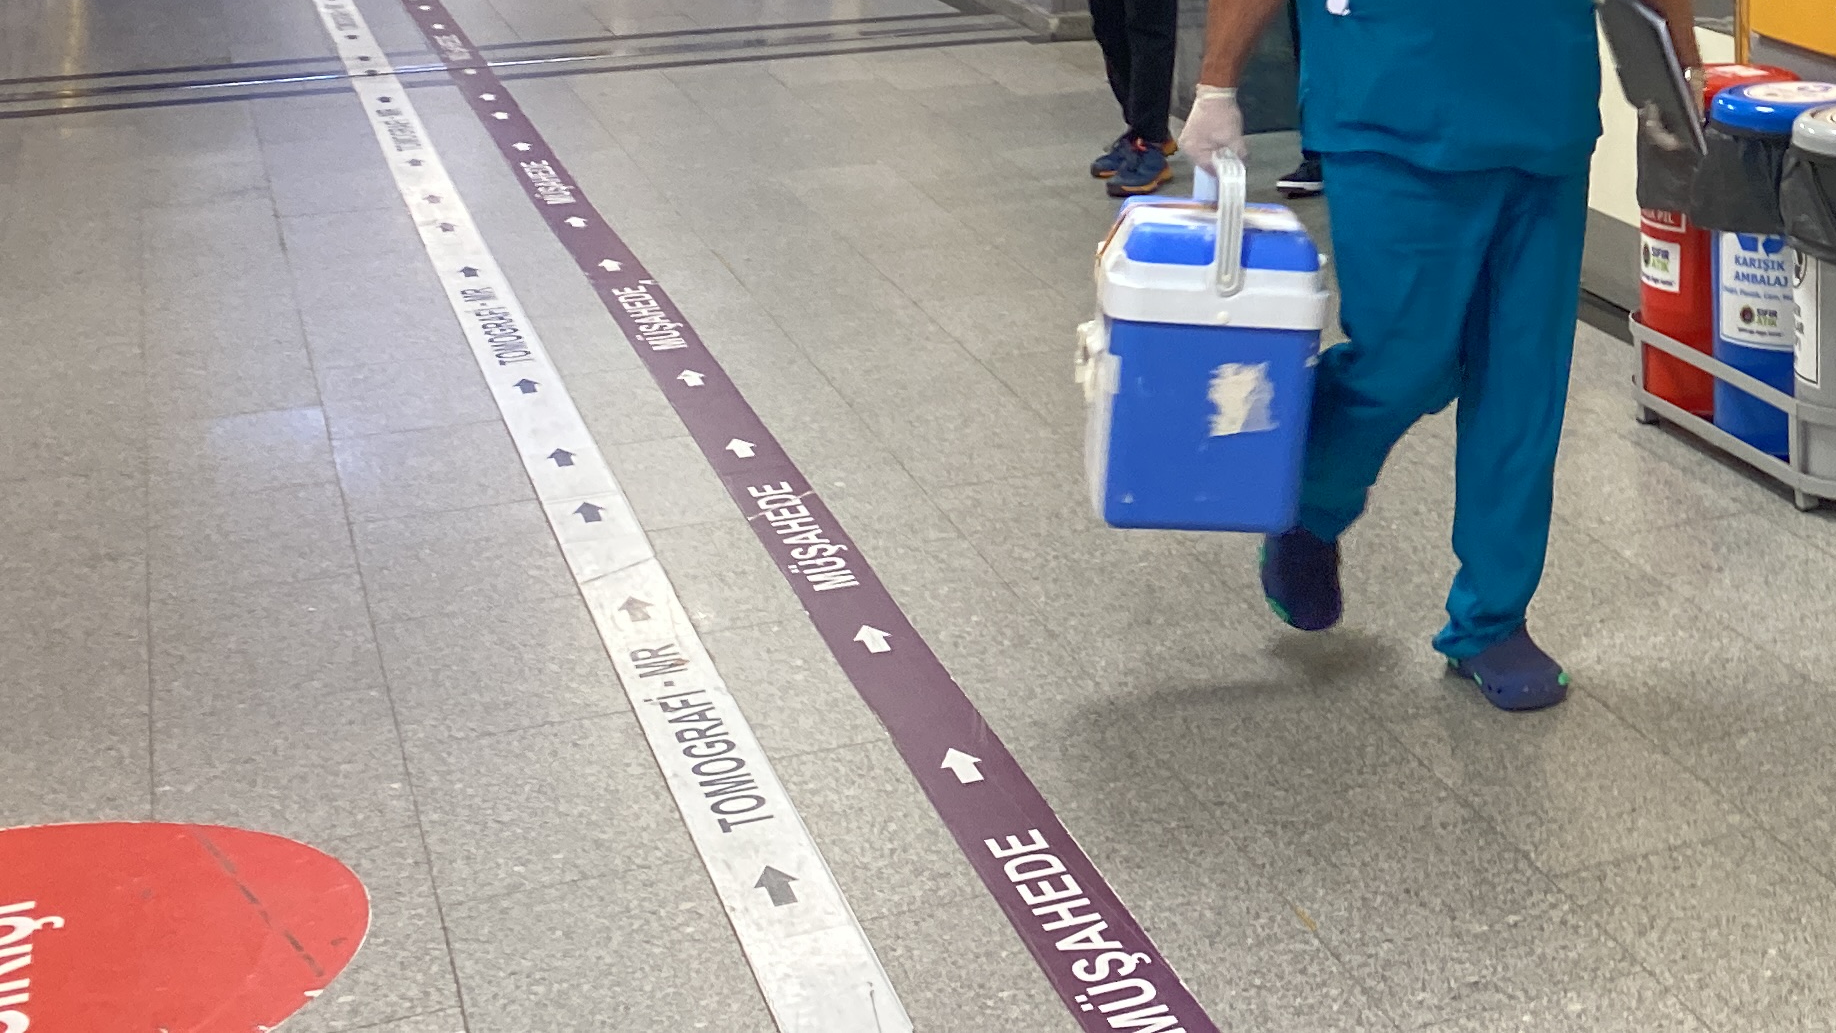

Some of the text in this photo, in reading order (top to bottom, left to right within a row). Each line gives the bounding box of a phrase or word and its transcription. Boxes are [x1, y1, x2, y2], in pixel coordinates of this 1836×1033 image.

[1734, 270, 1789, 287] AMBALAJ
[1735, 254, 1785, 272] KARIŞIK
[464, 307, 535, 366] TOMOGRAFİ
[611, 285, 688, 351] MÜŞAHEDE
[747, 481, 860, 591] MÜŞAHEDE
[629, 643, 691, 679] MR
[643, 689, 774, 834] TOMOGRAFİ
[984, 828, 1188, 1033] MÜŞAHEDE
